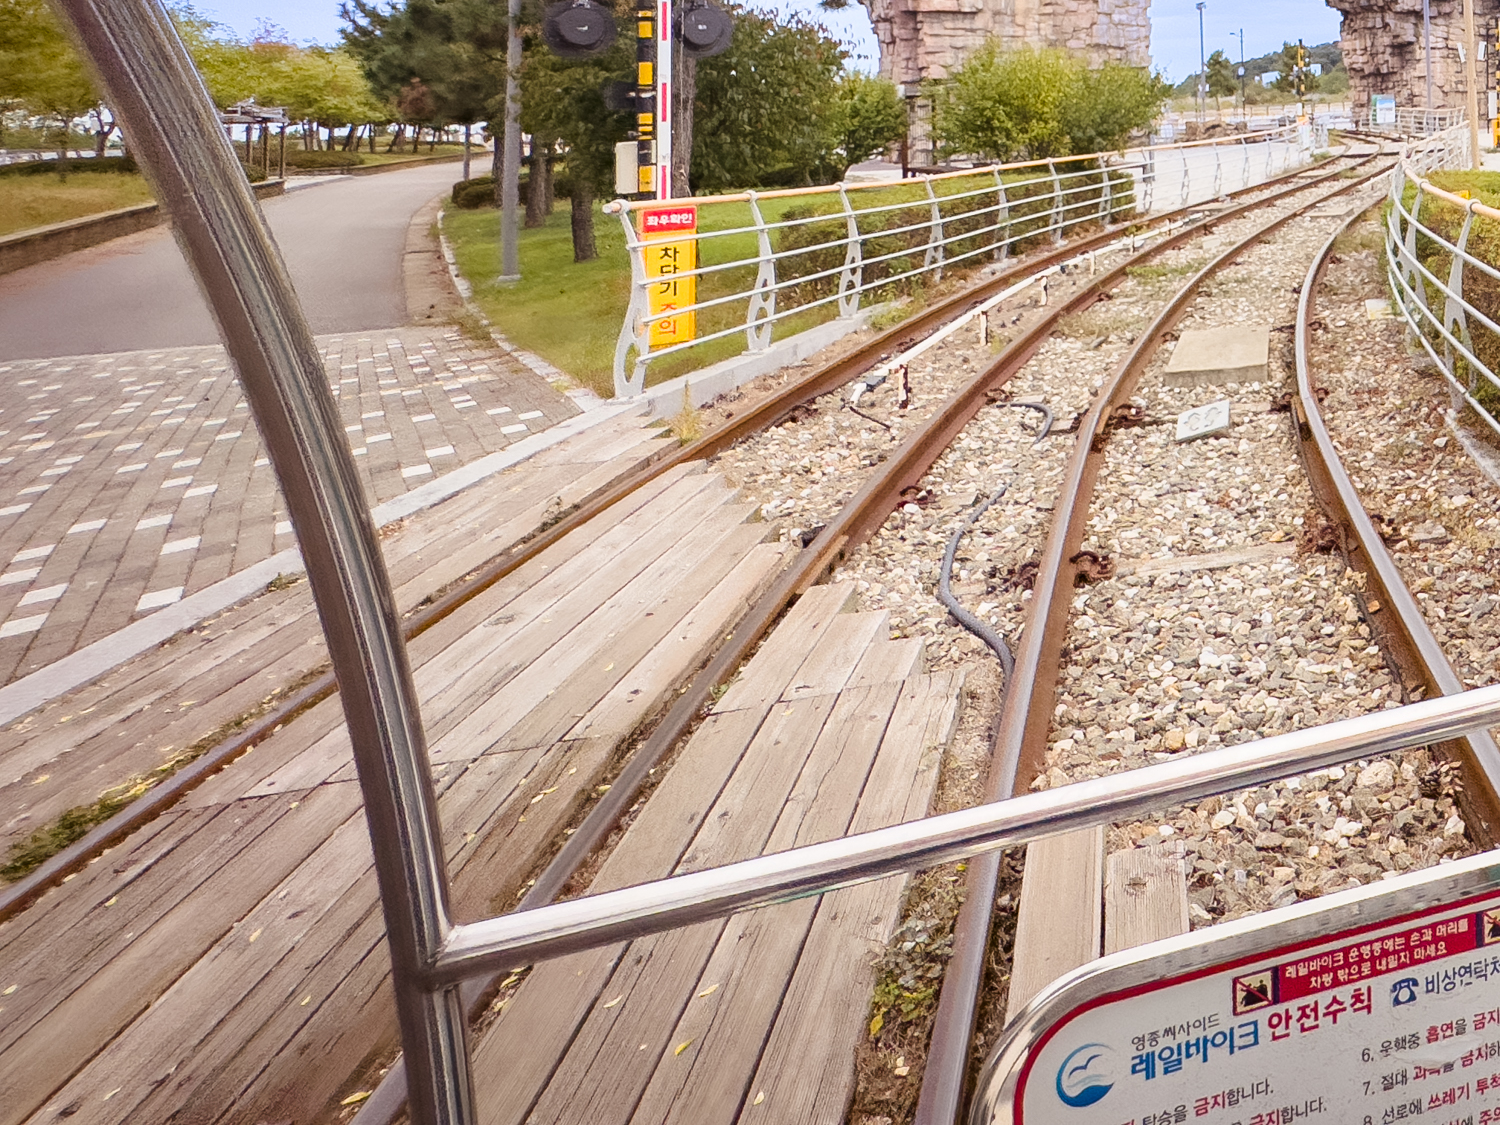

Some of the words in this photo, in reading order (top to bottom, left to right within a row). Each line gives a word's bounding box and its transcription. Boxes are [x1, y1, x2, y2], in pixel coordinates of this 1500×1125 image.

[647, 213, 693, 227] 좌우확인
[1284, 951, 1345, 979] 레일바이크
[1348, 935, 1406, 963] 운행중에는
[1410, 928, 1433, 947] 손과
[1435, 918, 1469, 941] 머리를
[1309, 971, 1332, 989] 차량
[1337, 962, 1371, 983] 밖으로
[1375, 950, 1410, 971] 내밀지
[1414, 942, 1448, 961] 마세요
[1130, 1019, 1260, 1081] 레일바이크
[1267, 985, 1372, 1042] 안전수칙
[1131, 1012, 1220, 1051] 영종씨사이드
[1362, 1048, 1374, 1062] 6.
[1425, 1018, 1468, 1044] 흡연을
[1193, 1078, 1274, 1117] 금지합니다.
[1362, 1081, 1375, 1095] 7.
[1380, 1068, 1408, 1092] 절대
[1381, 1099, 1423, 1125] 선로에
[1427, 1081, 1470, 1111] 쓰레기
